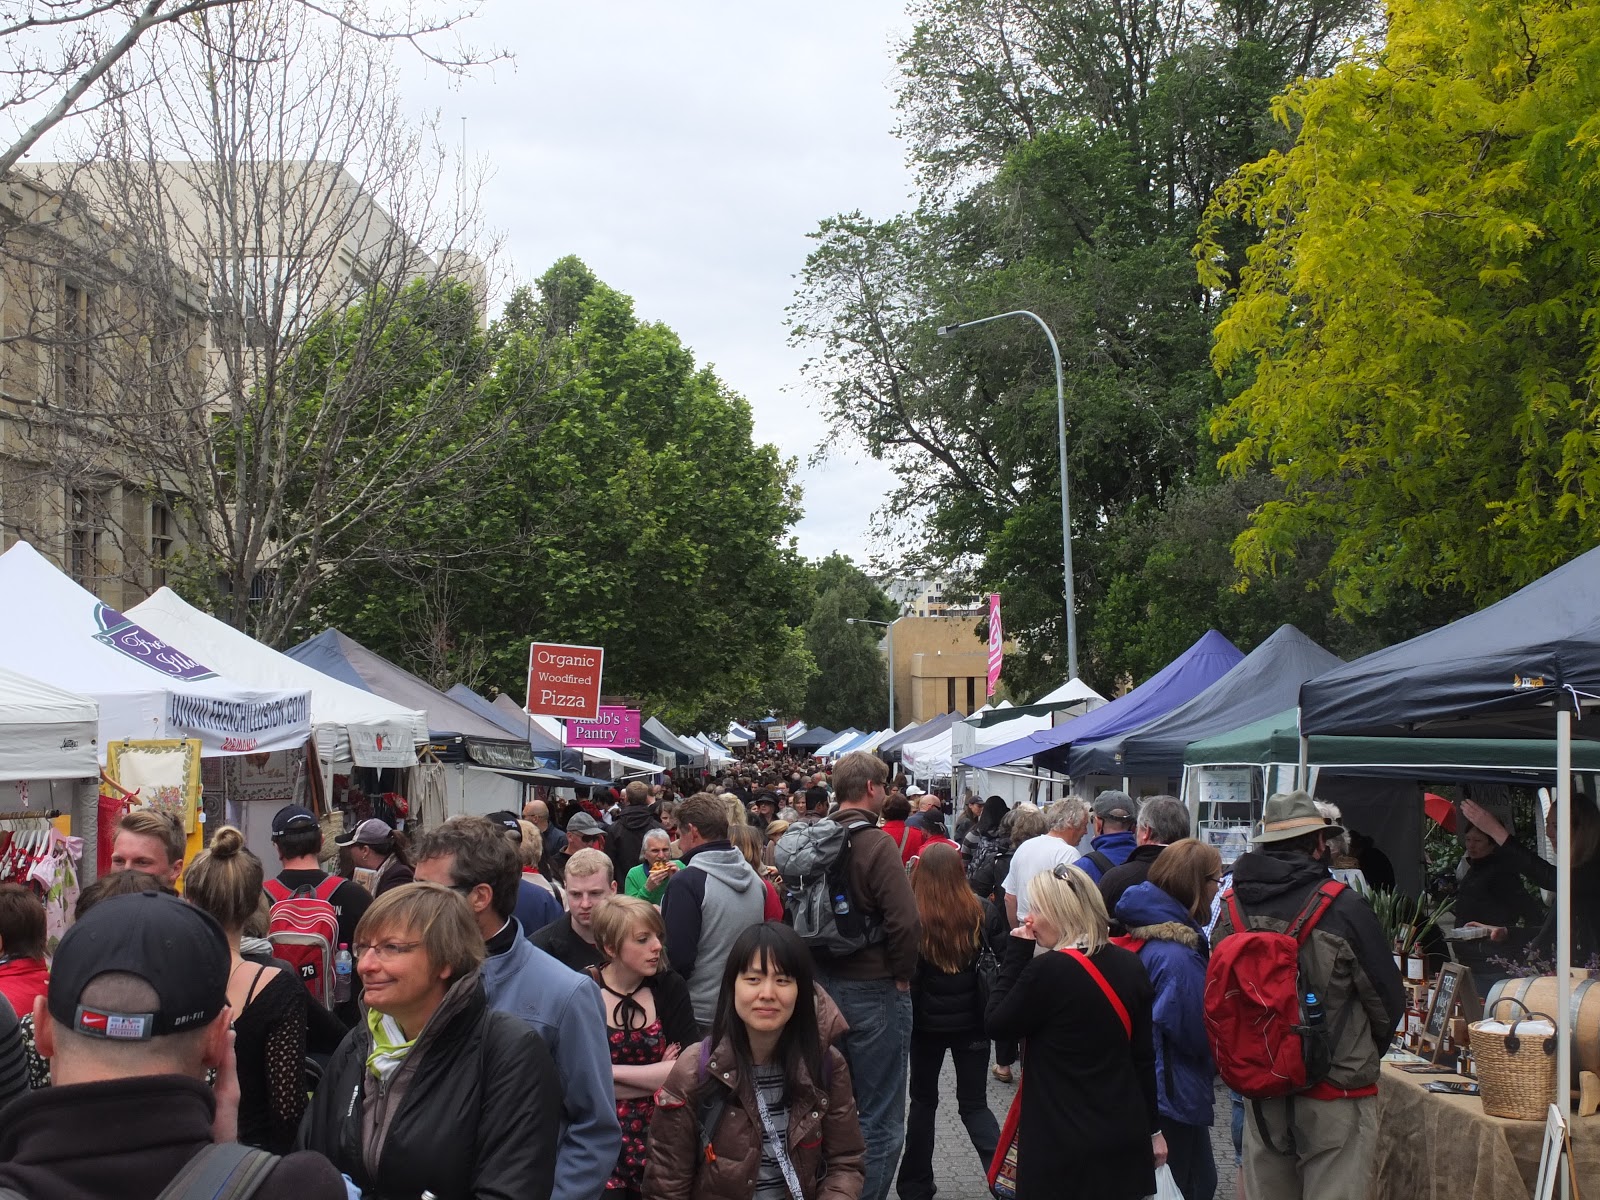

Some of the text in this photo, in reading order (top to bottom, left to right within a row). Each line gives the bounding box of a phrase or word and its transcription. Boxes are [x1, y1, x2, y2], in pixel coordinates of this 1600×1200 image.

[537, 651, 595, 668] Organic
[538, 671, 592, 685] Woodfired
[540, 689, 586, 708] Pizza
[575, 726, 618, 743] Pantry
[301, 964, 315, 978] 76
[174, 1011, 205, 1026] DRI-FIT
